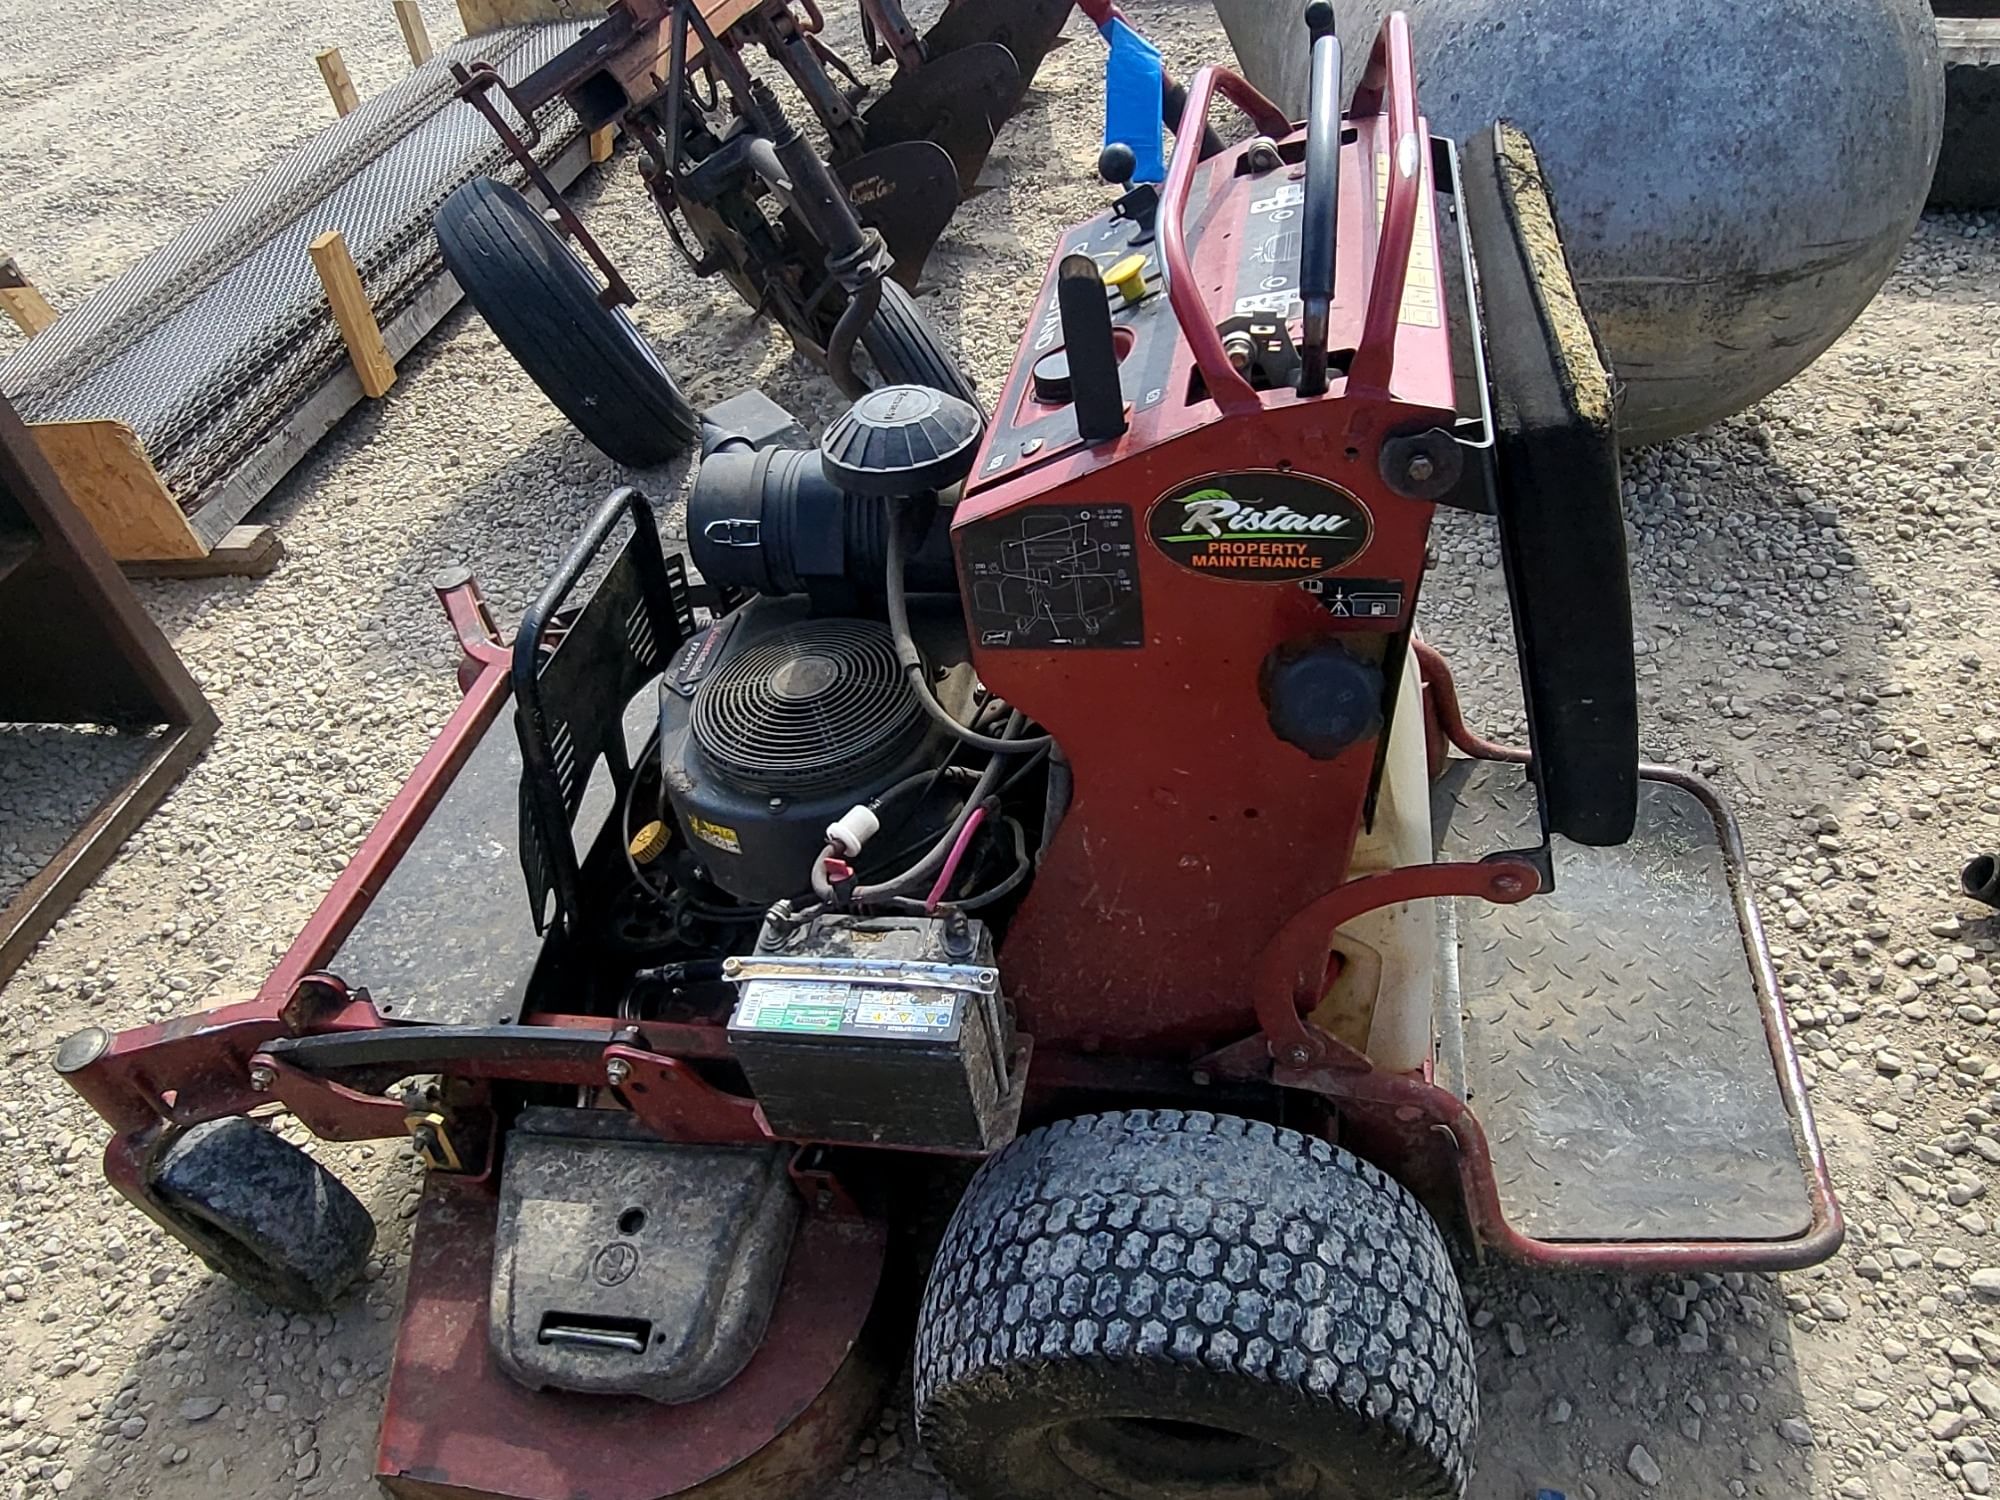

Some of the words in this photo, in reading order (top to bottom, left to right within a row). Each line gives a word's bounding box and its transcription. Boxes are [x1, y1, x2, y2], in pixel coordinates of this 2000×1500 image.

[1181, 500, 1350, 538] Ristau
[1208, 542, 1308, 555] PROPERTY
[1192, 555, 1322, 569] MAINTENANCE
